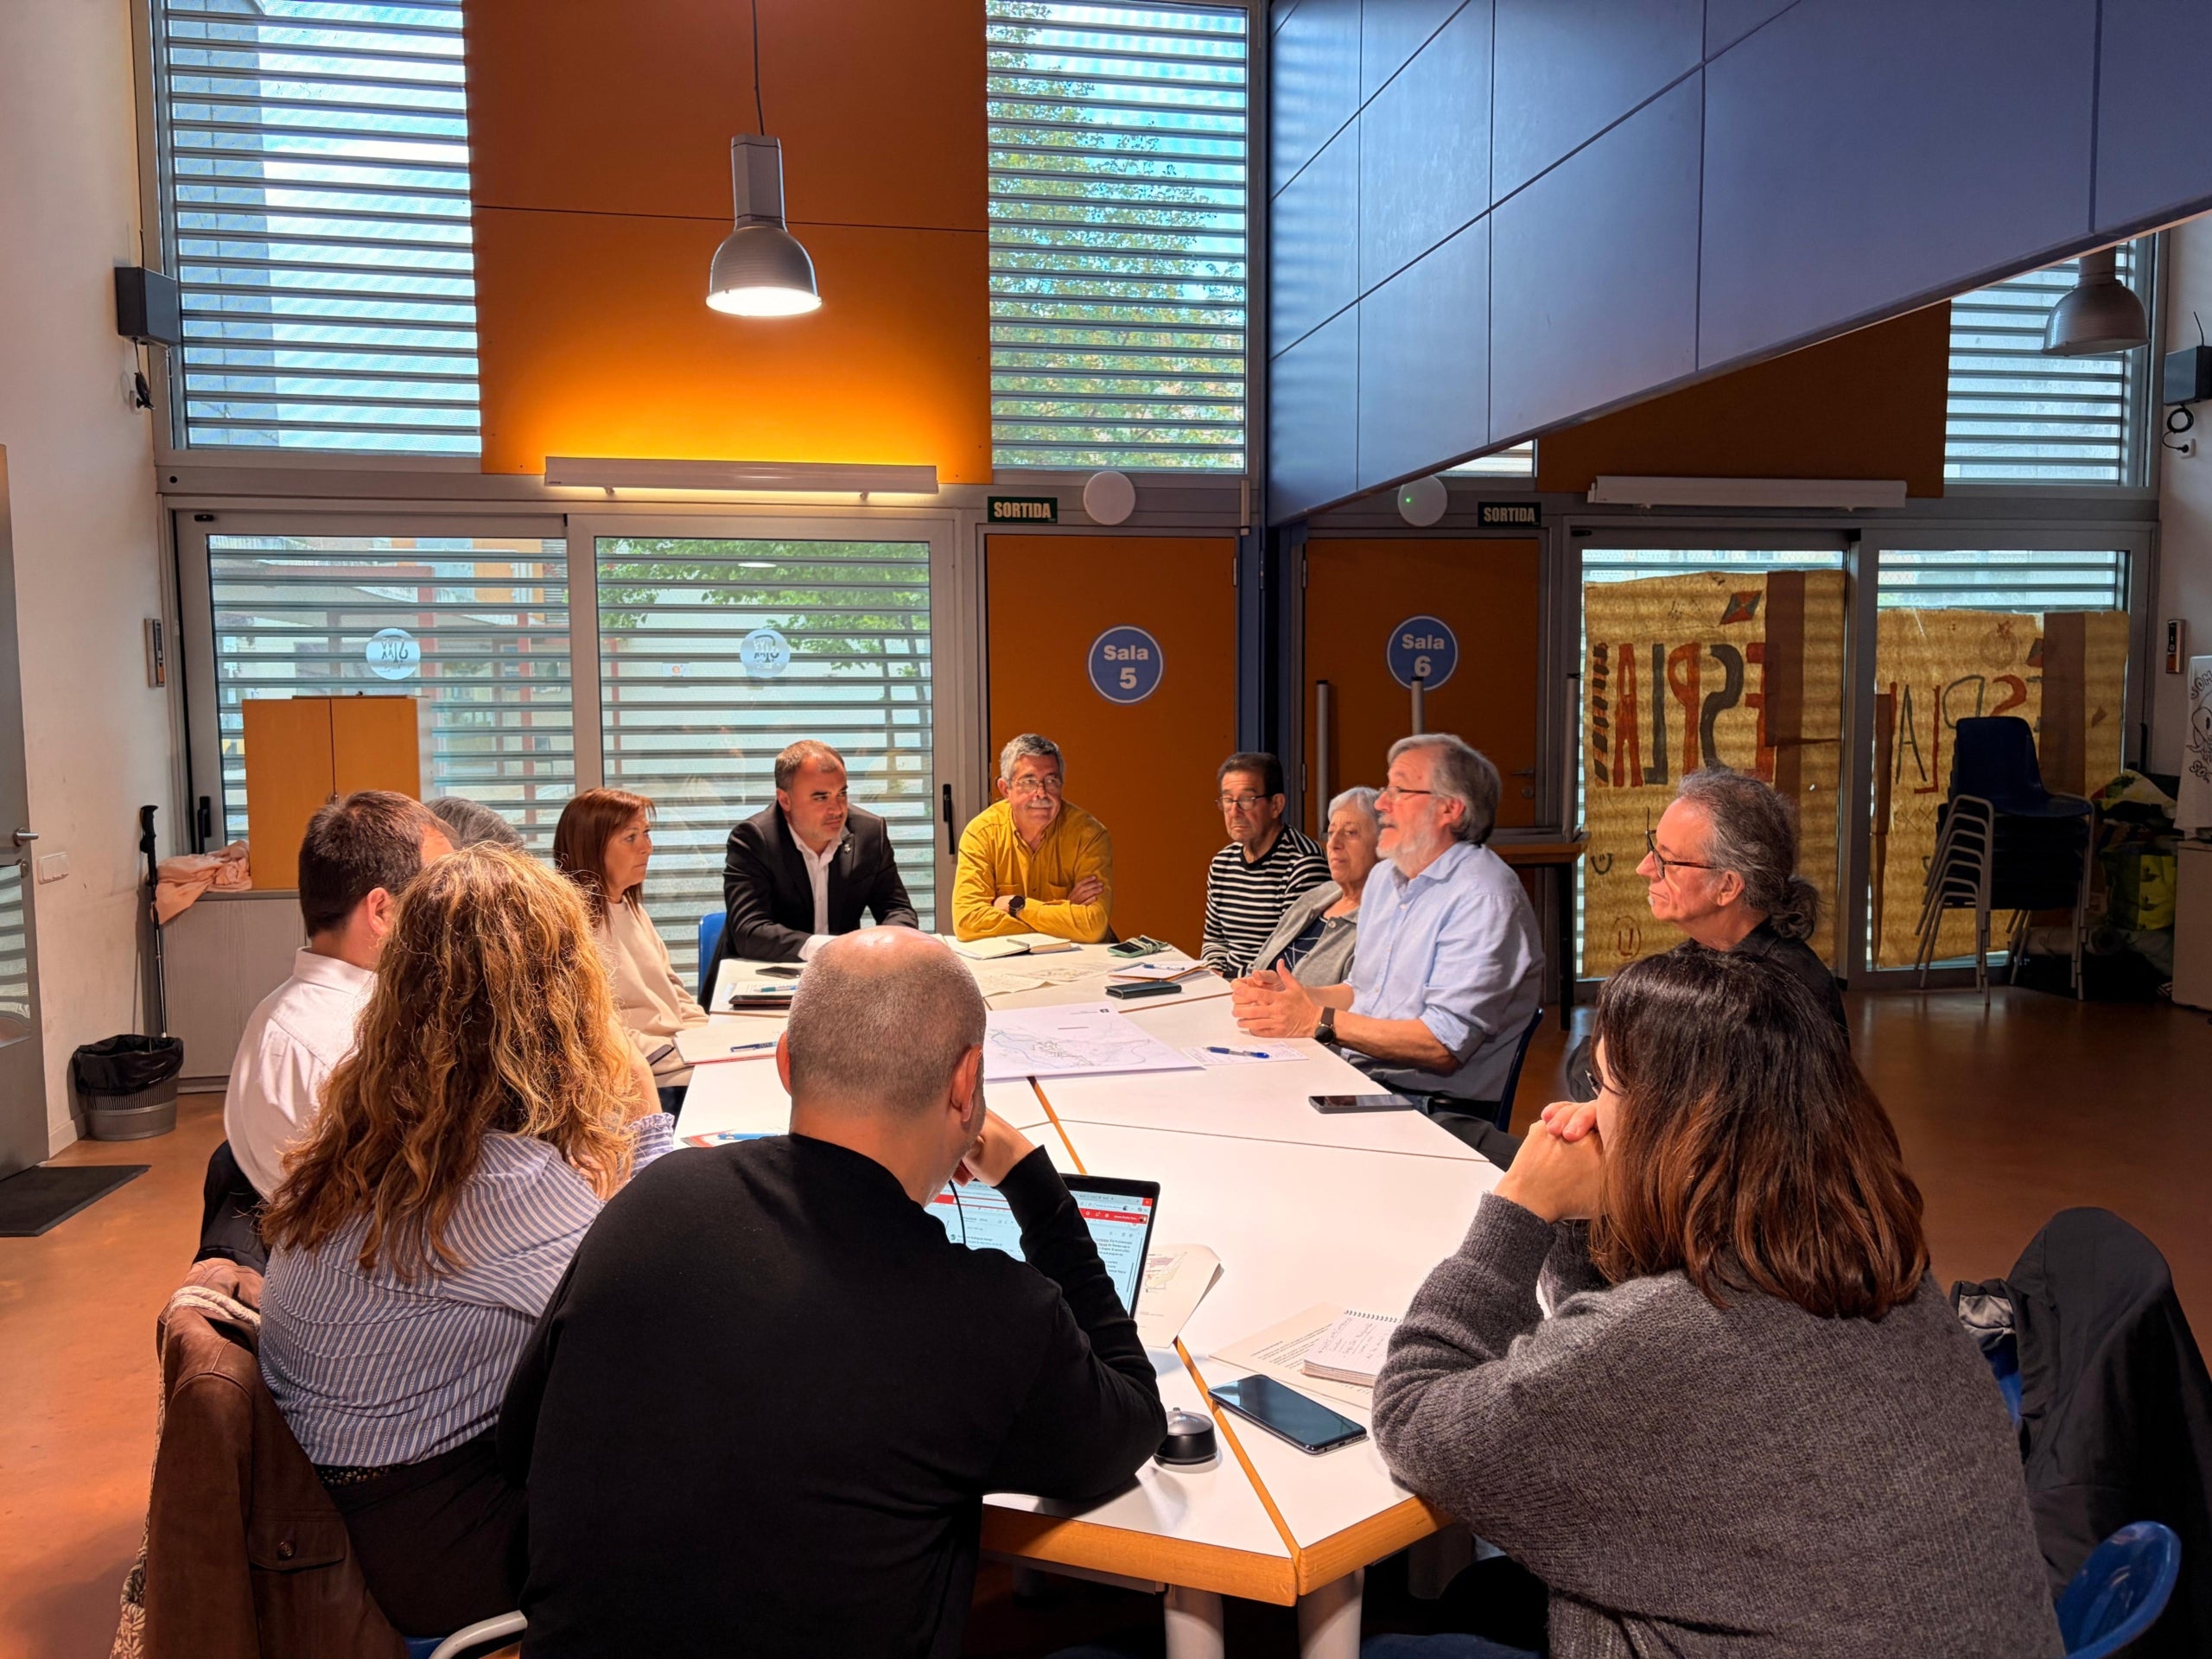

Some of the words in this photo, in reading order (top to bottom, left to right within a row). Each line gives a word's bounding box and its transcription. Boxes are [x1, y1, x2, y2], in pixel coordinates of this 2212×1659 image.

[994, 502, 1052, 518] SORTIDA
[1484, 507, 1535, 522] SORTIDA
[1402, 633, 1445, 650] Sala
[1103, 645, 1149, 661] Sala
[1414, 655, 1432, 677] 6
[1119, 666, 1138, 690] 5
